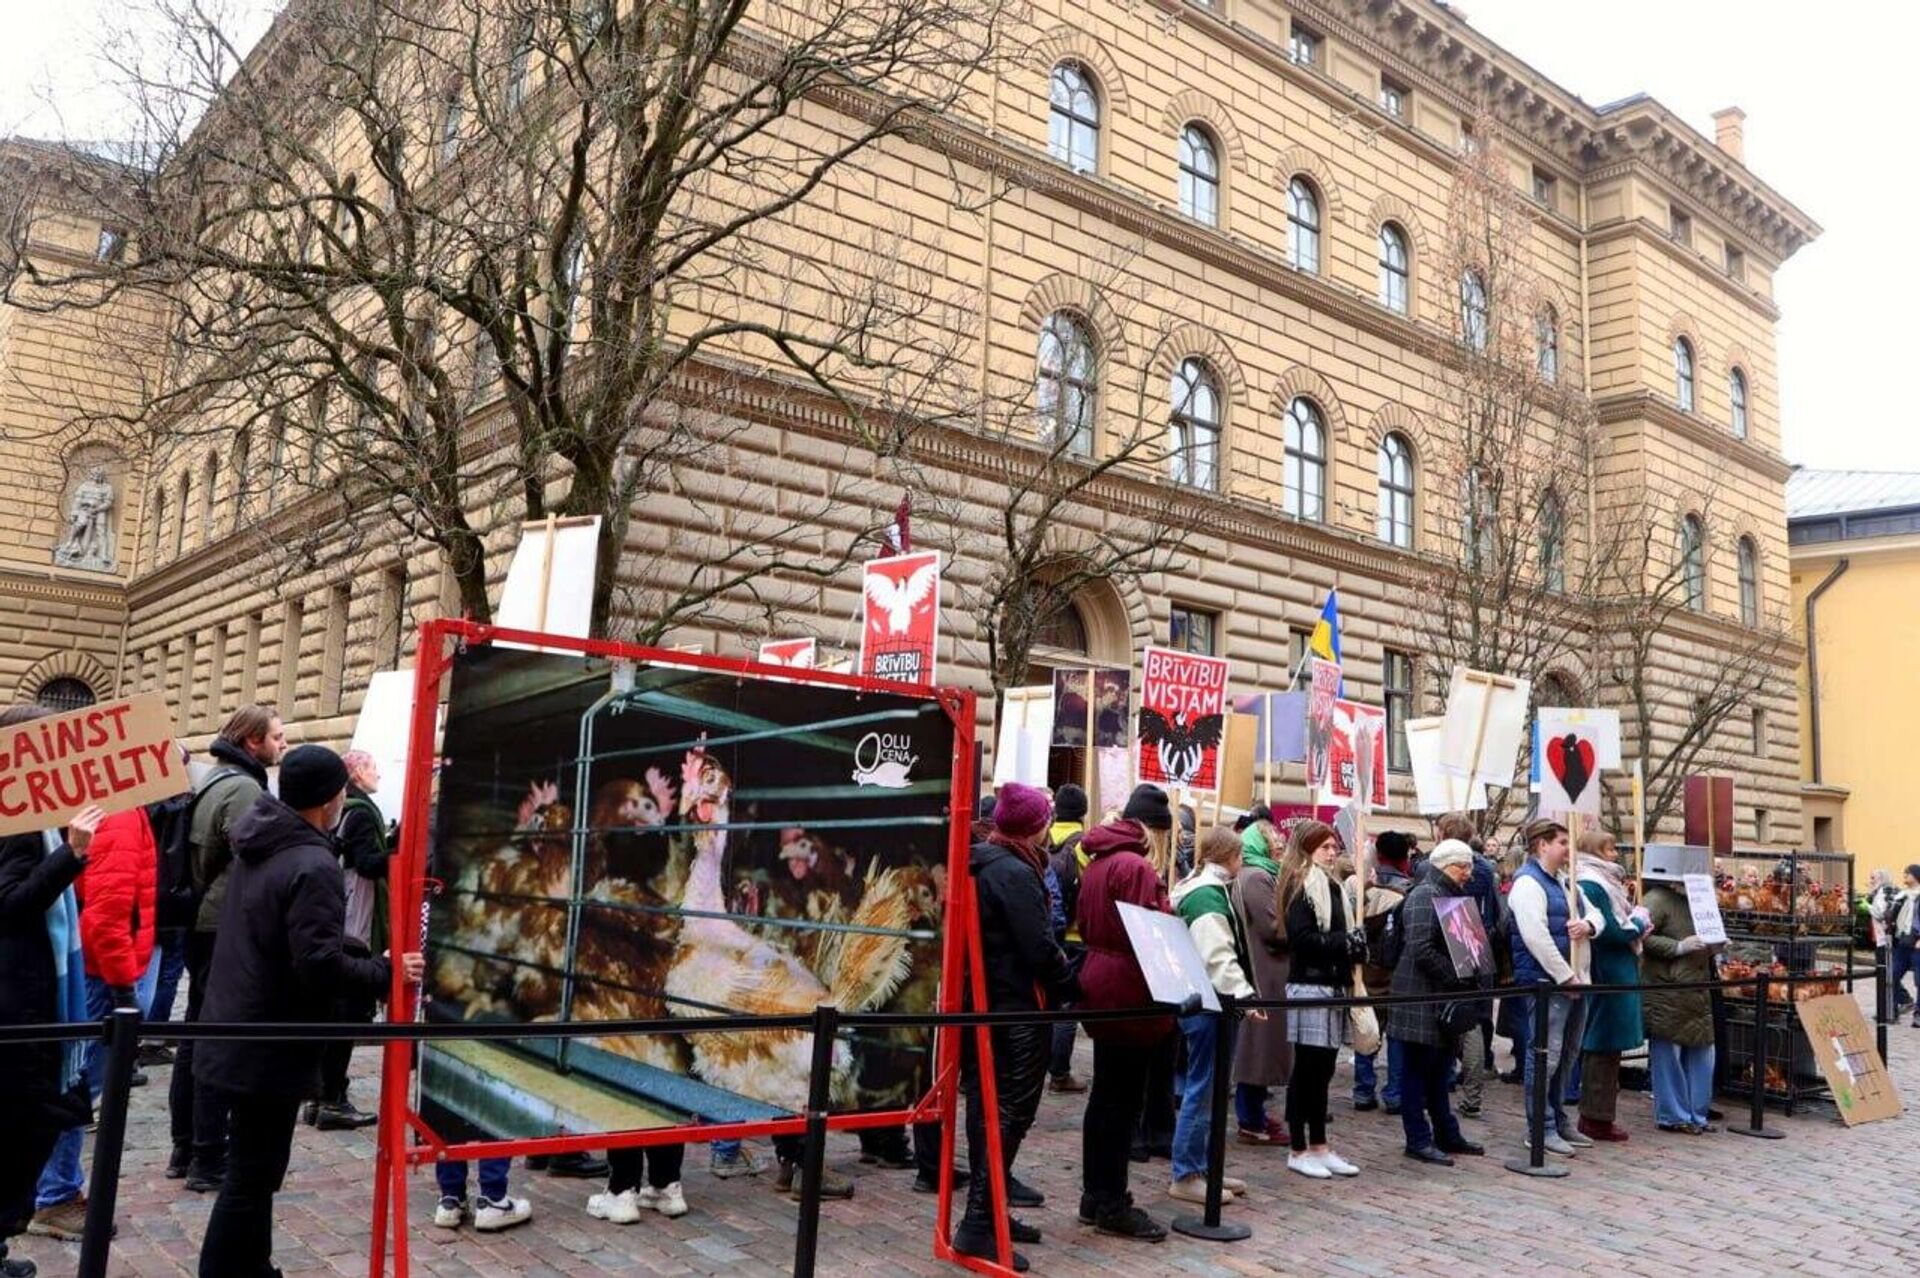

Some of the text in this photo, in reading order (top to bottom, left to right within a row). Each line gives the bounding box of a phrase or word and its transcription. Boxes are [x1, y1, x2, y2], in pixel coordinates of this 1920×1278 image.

[1148, 653, 1224, 688] BRĪVĪBU
[1147, 680, 1219, 714] VISTĀM
[881, 749, 910, 762] CENA
[882, 733, 911, 750] OLU
[0, 740, 171, 817] CRUELTY
